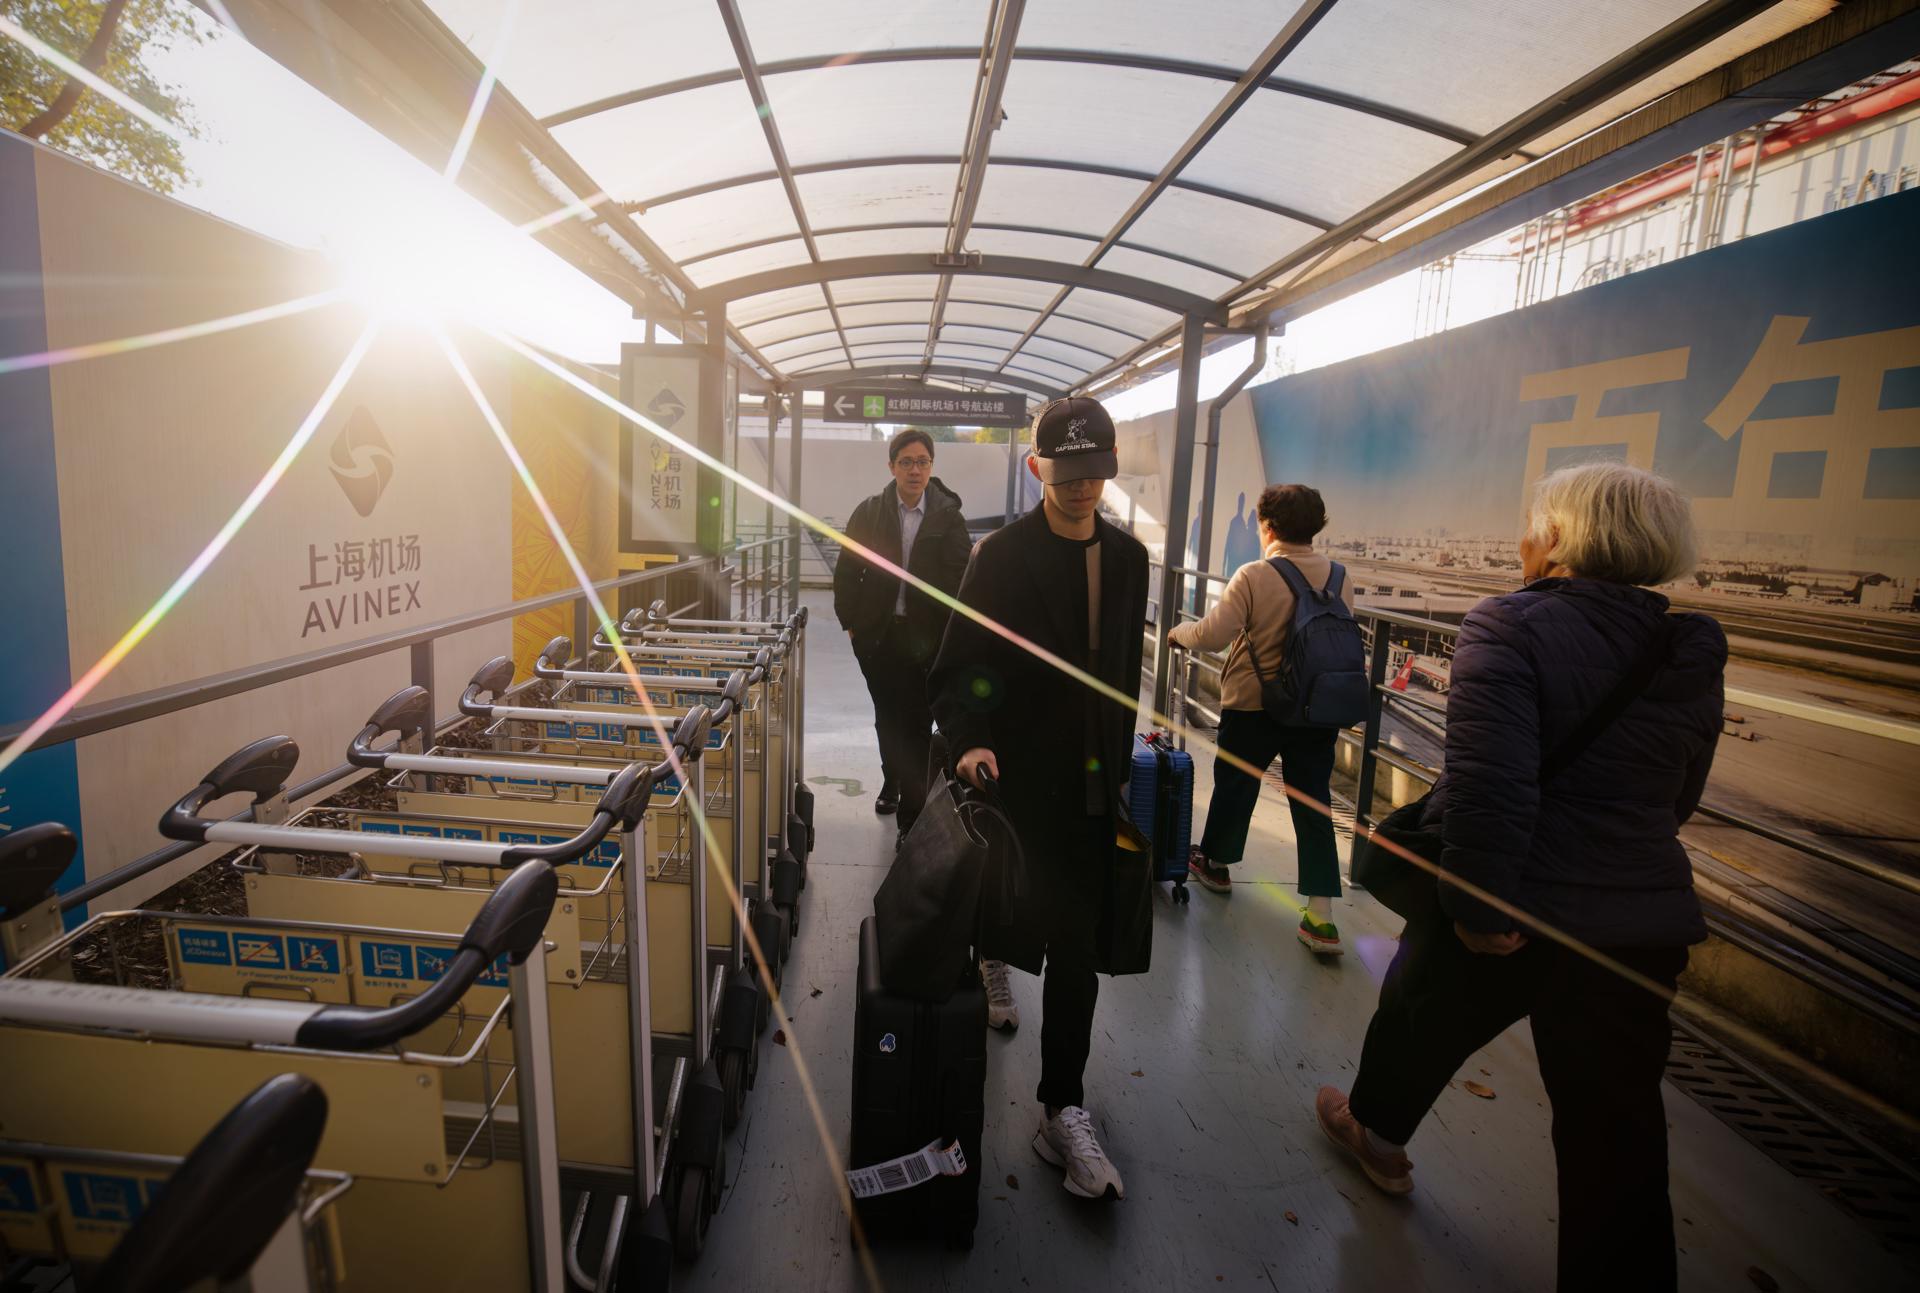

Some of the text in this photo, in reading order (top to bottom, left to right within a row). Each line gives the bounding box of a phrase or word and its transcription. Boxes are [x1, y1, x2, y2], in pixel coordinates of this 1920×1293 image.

[887, 398, 1005, 413] 虹桥国际机场1号航站楼
[650, 438, 662, 510] AVINEX
[1055, 444, 1081, 452] CAPTAIN
[299, 533, 422, 591] 上海机场
[301, 579, 423, 638] AVINEX
